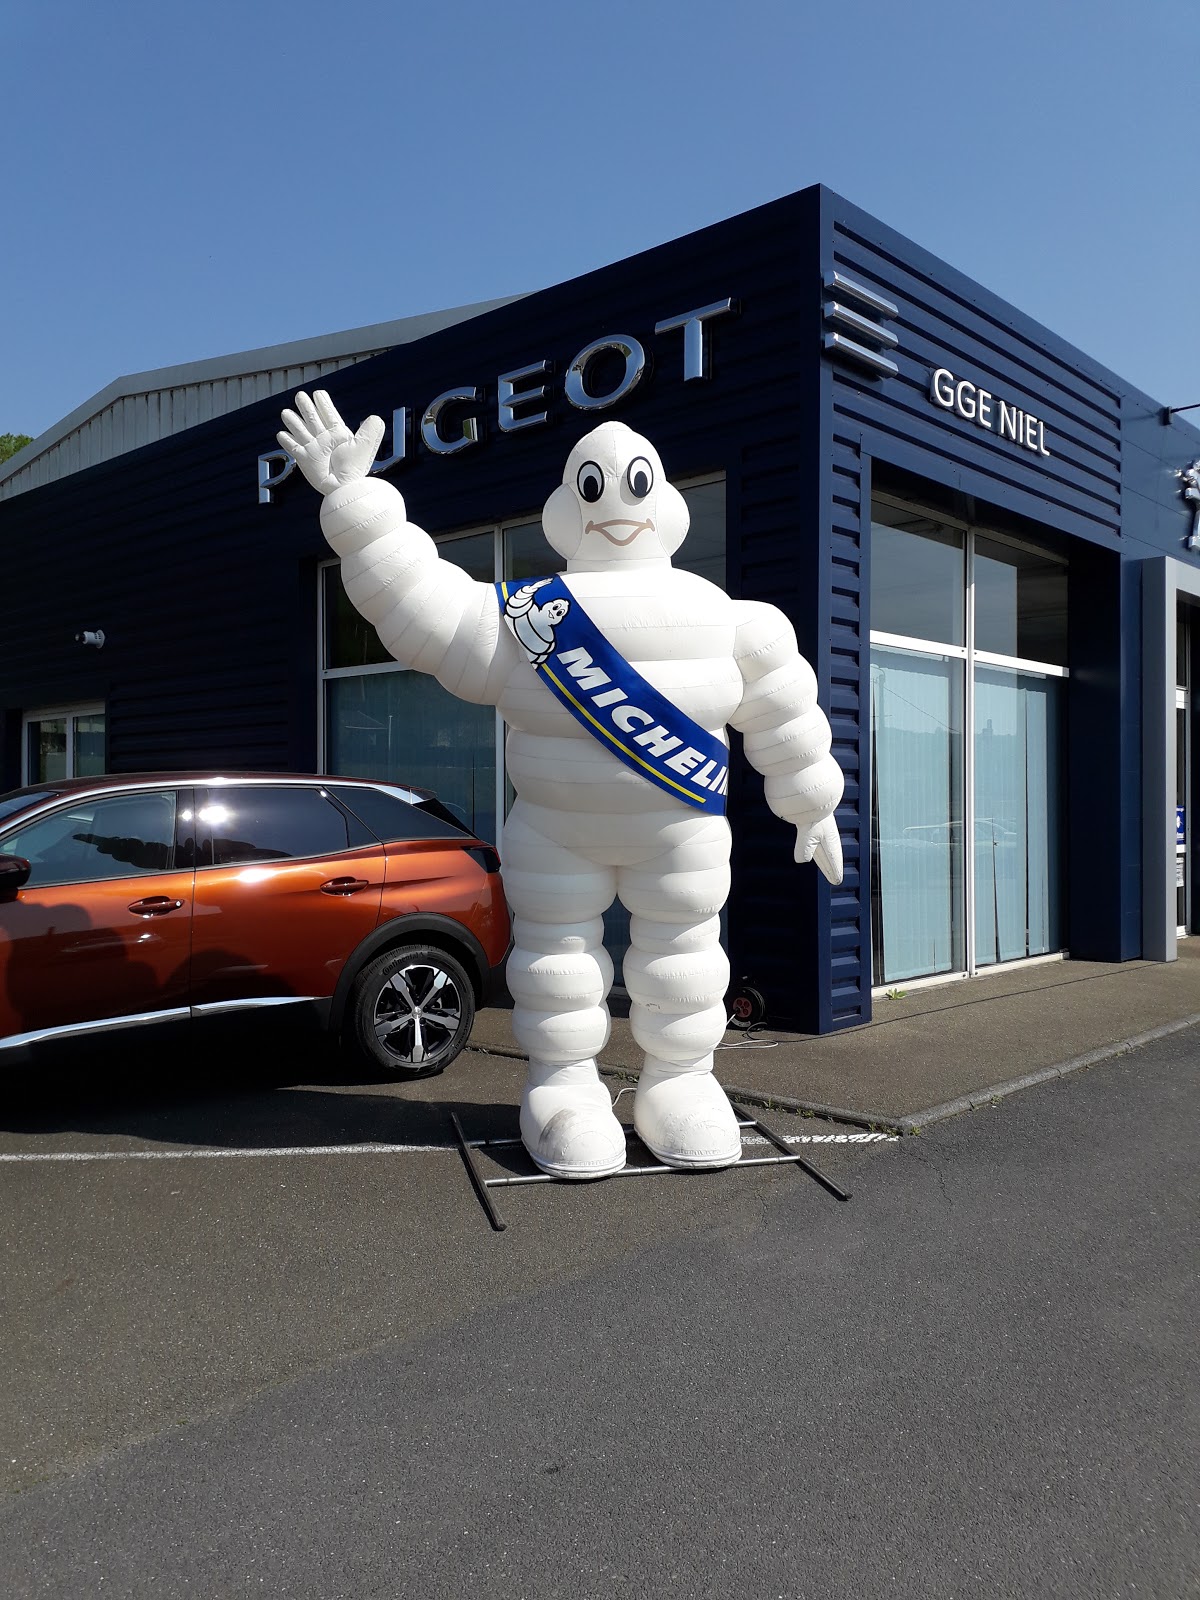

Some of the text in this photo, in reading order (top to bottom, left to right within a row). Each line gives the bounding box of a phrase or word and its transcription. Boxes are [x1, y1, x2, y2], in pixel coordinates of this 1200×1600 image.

[258, 297, 736, 504] PUGEOT
[932, 368, 1050, 456] GGE NIEL
